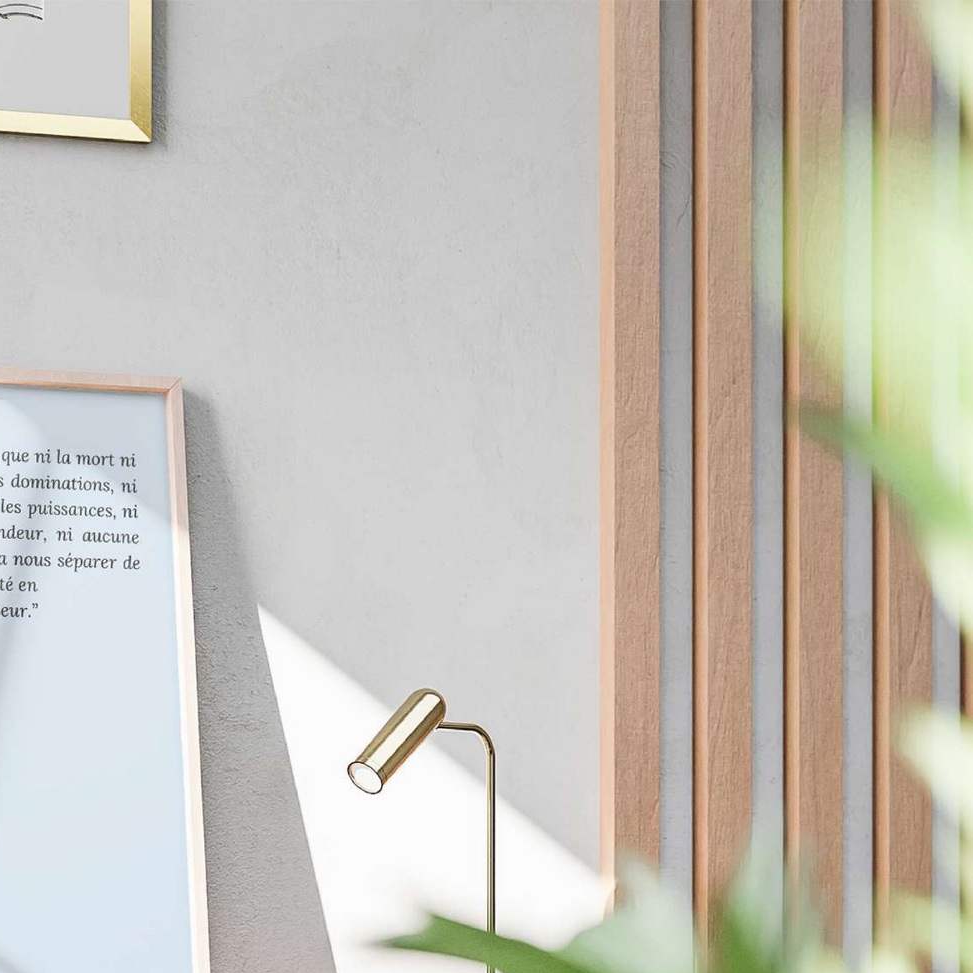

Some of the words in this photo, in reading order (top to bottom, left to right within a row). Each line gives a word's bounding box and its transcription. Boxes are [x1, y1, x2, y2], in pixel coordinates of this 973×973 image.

[1, 450, 30, 467] que
[33, 448, 53, 465] ni
[56, 448, 73, 466] la
[75, 453, 116, 468] mort
[118, 452, 137, 468] ni
[10, 472, 115, 496] dominations,
[120, 478, 139, 494] ni
[0, 497, 22, 515] les
[26, 499, 117, 521] puissances,
[121, 503, 139, 519] ni
[55, 526, 74, 542] ni
[81, 530, 140, 545] aucune
[11, 554, 52, 568] nous
[56, 551, 118, 573] séparer
[122, 554, 141, 571] de
[17, 579, 39, 593] en
